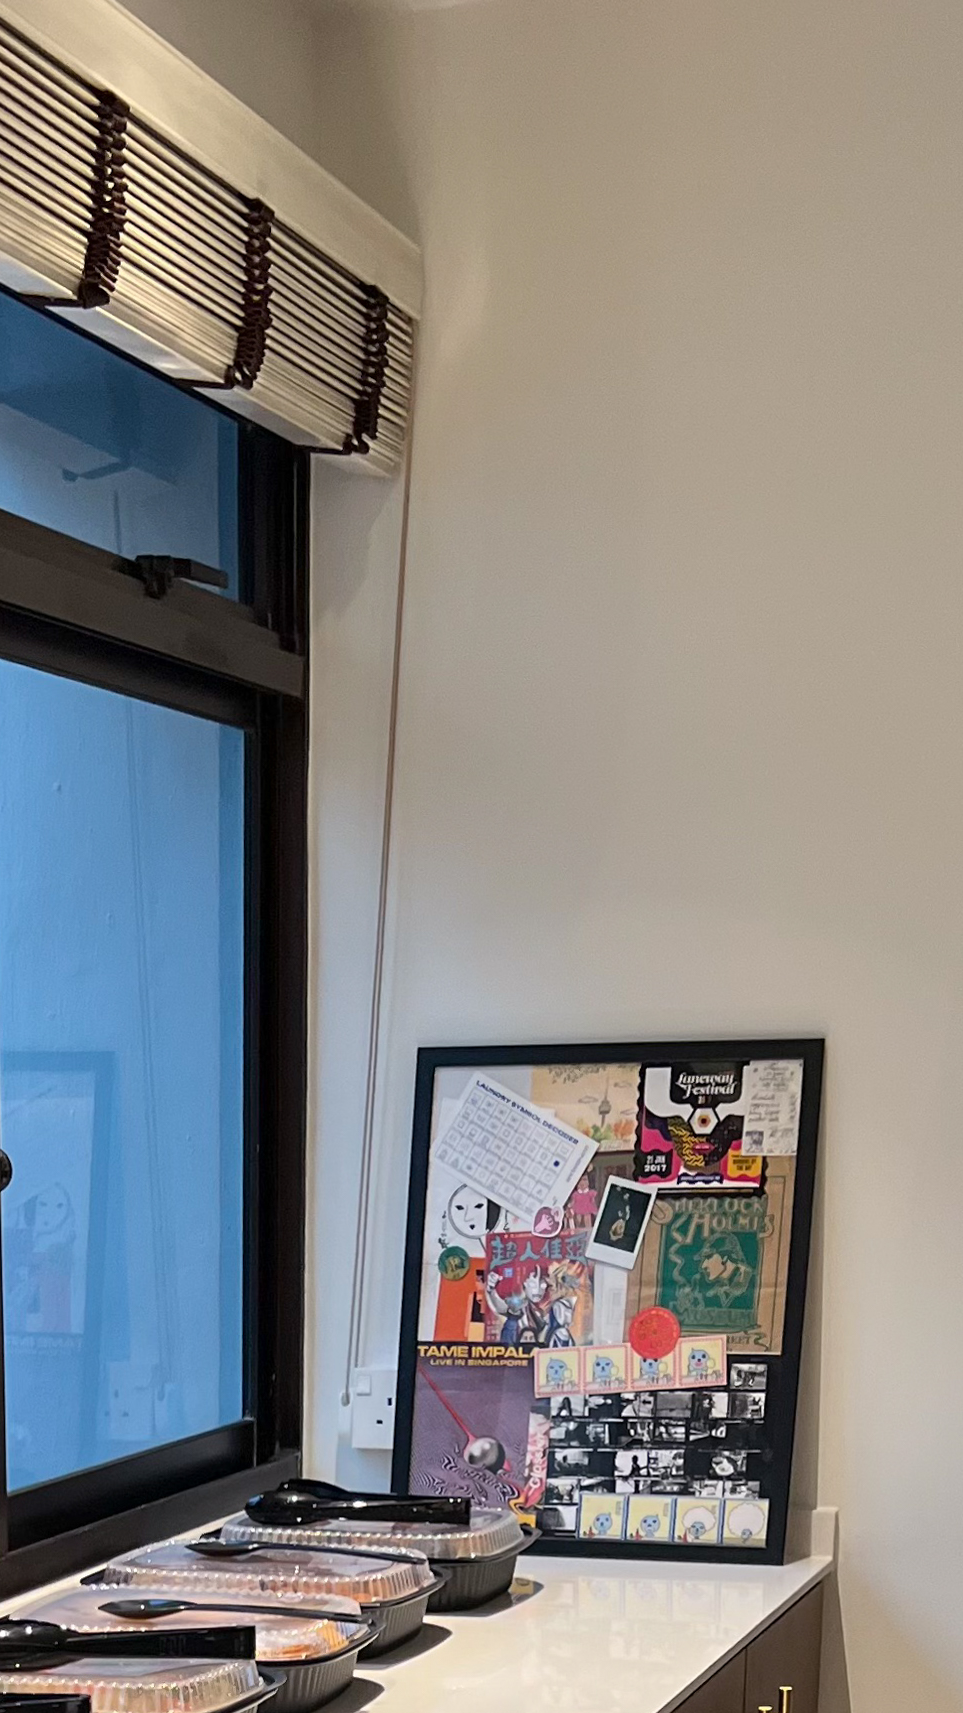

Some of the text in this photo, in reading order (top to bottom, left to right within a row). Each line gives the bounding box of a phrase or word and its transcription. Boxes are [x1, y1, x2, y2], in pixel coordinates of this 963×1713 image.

[676, 1072, 735, 1089] Laneway
[682, 1083, 737, 1099] Festival
[476, 1080, 579, 1145] LAUNDRY SYMBOL DECODER
[644, 1164, 667, 1173] 2017
[417, 1345, 469, 1357] TAME
[430, 1358, 529, 1367] LIVE IN SINGAPORE
